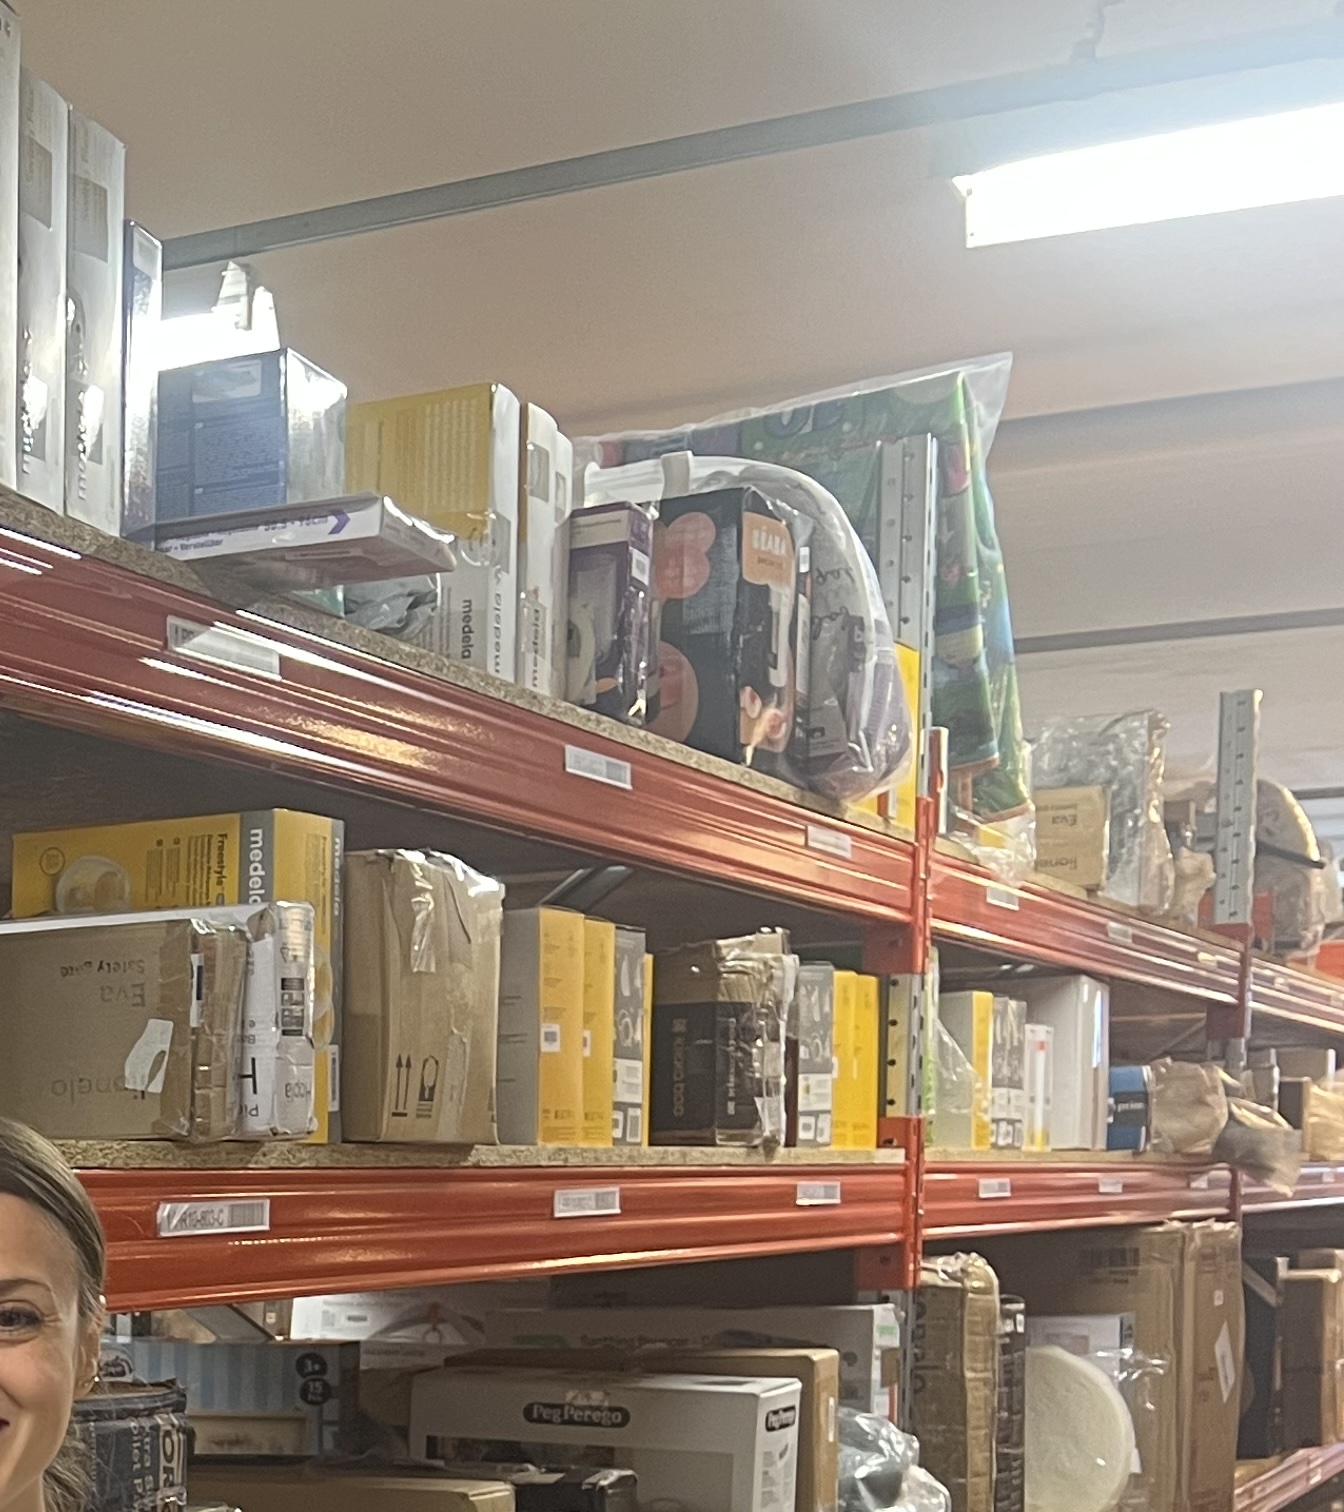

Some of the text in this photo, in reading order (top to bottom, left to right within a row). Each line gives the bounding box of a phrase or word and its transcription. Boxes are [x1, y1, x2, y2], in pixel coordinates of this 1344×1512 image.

[461, 599, 474, 660] medela
[493, 592, 502, 674] medela
[216, 833, 229, 887] Freestyle
[248, 828, 267, 904] medela
[333, 837, 341, 916] medela
[100, 983, 146, 1006] Eva
[531, 1405, 622, 1426] Peg Perego
